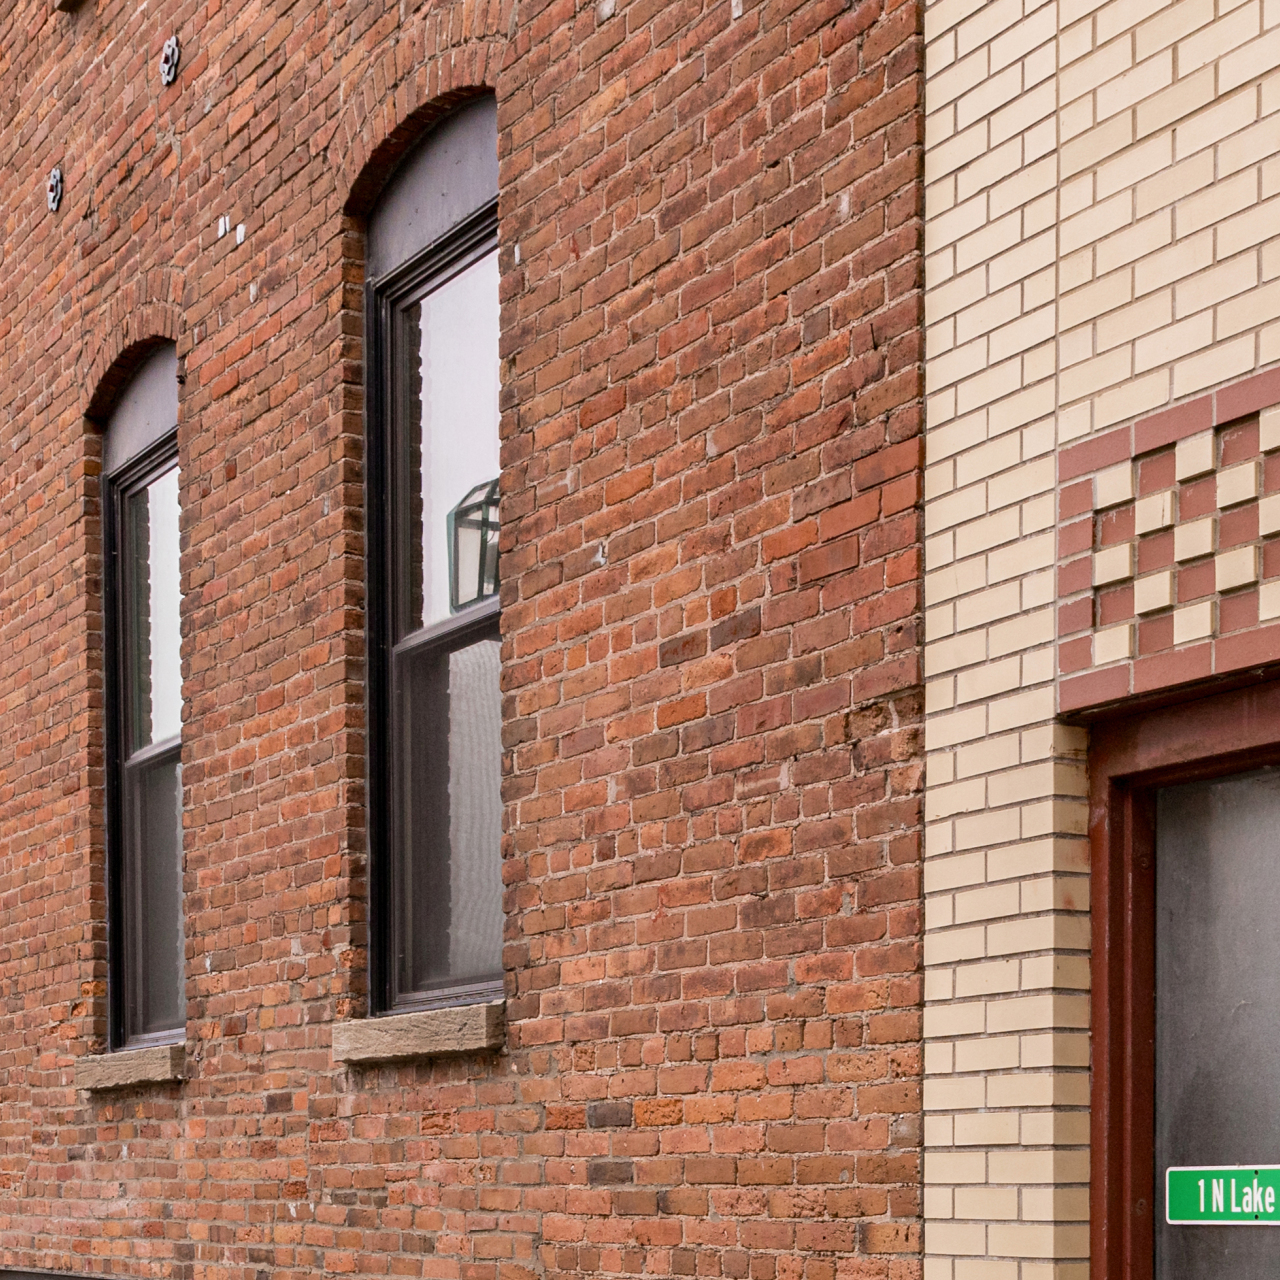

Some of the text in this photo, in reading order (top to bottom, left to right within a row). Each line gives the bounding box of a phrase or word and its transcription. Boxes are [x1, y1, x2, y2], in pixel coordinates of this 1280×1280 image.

[1197, 1178, 1205, 1213] 1
[1211, 1178, 1224, 1213] N
[1230, 1177, 1275, 1214] Lake
